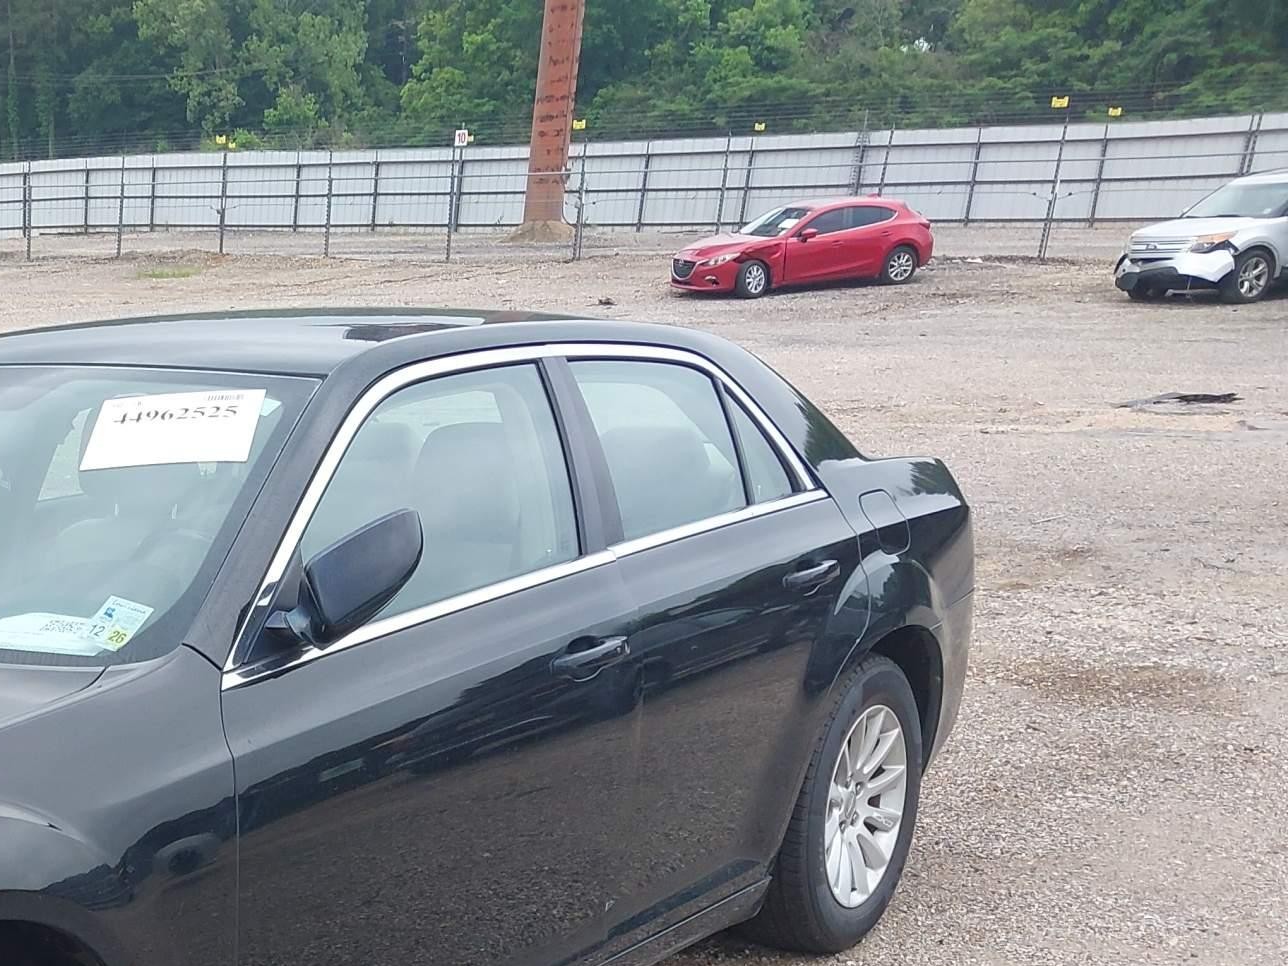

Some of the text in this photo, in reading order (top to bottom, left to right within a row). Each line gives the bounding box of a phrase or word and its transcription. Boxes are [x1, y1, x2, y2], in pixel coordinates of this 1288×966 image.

[457, 132, 466, 144] 10
[113, 404, 240, 425] 44962525
[87, 623, 106, 637] 12
[107, 630, 127, 644] 26
